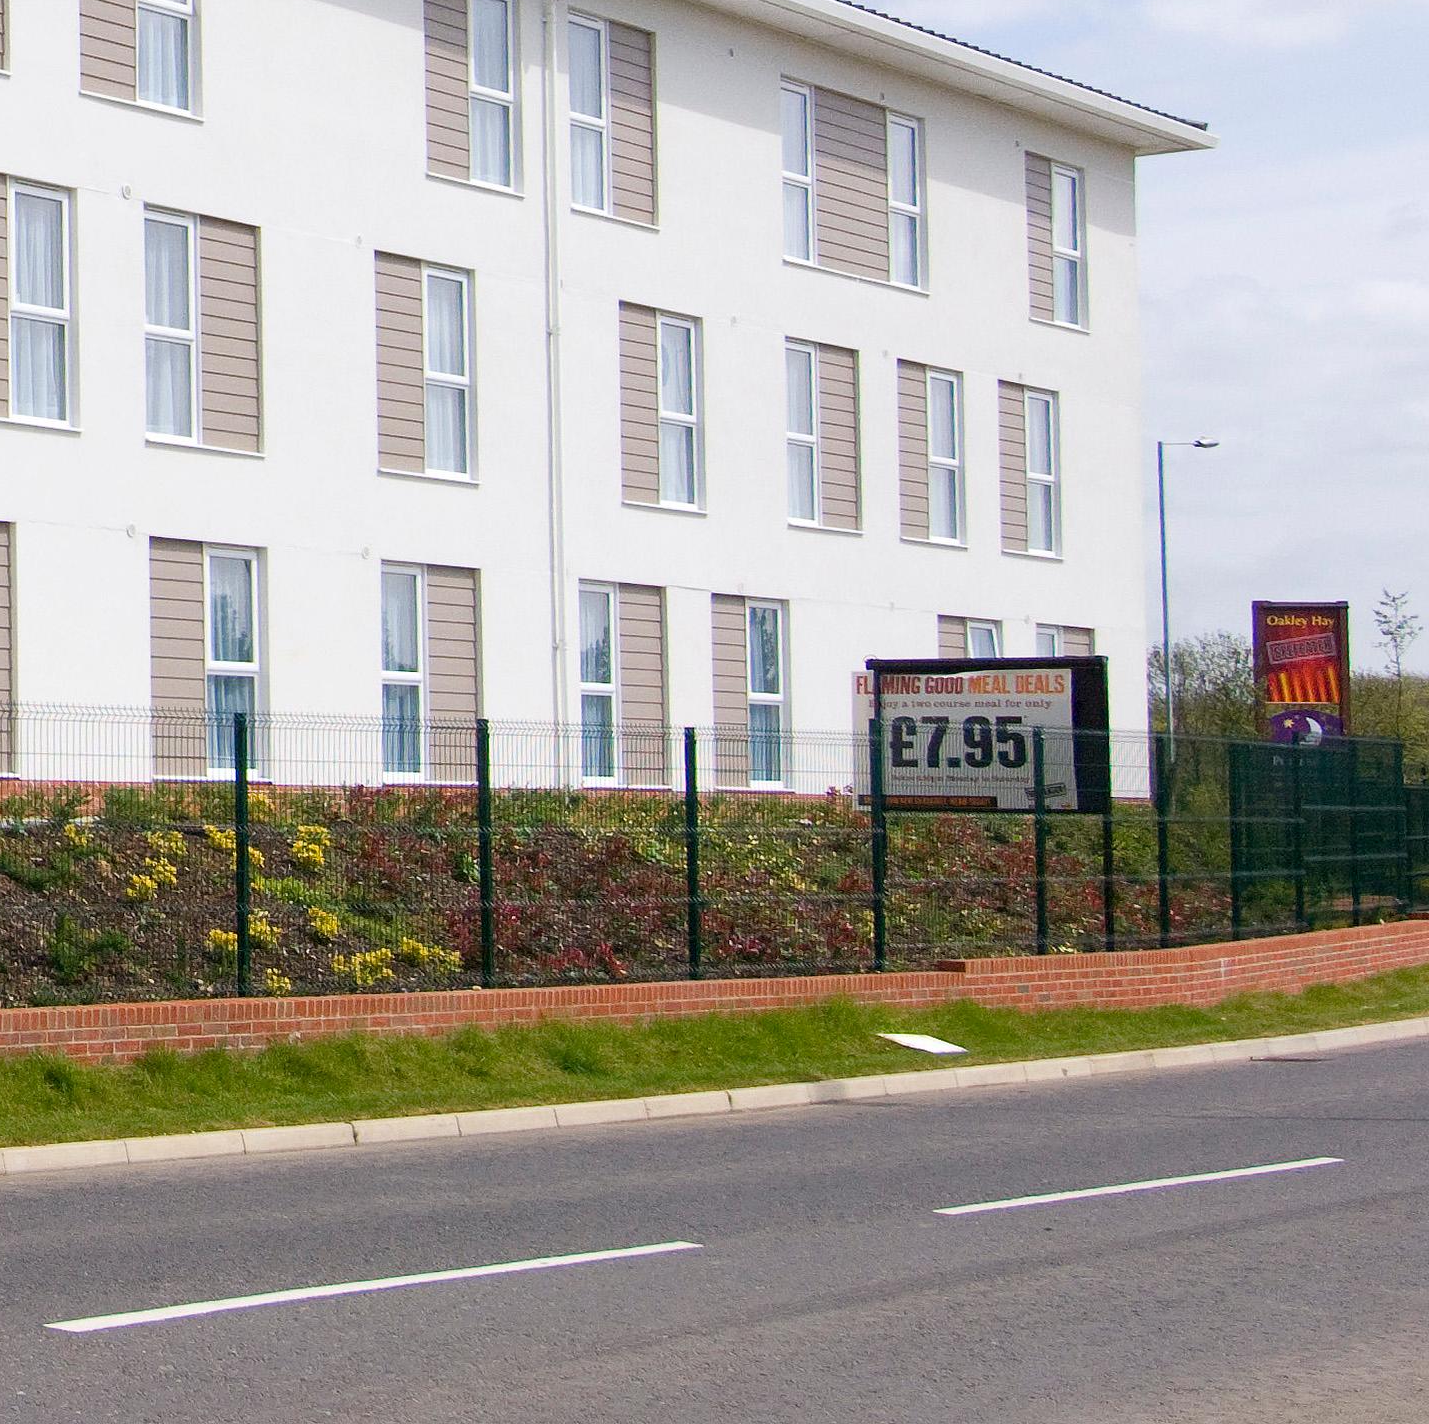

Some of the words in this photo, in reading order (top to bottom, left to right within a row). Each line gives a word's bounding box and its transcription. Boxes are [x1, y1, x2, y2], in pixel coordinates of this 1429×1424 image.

[1266, 615, 1308, 629] Oakley
[1311, 615, 1335, 629] Hay
[855, 675, 921, 695] FLMING
[924, 676, 964, 695] GOOD
[967, 674, 1011, 694] MEAL
[1015, 673, 1065, 694] DEALS
[868, 699, 899, 709] Ejoy
[933, 700, 971, 708] course
[974, 699, 1001, 708] meal
[1004, 699, 1022, 708] for
[1024, 699, 1052, 709] only
